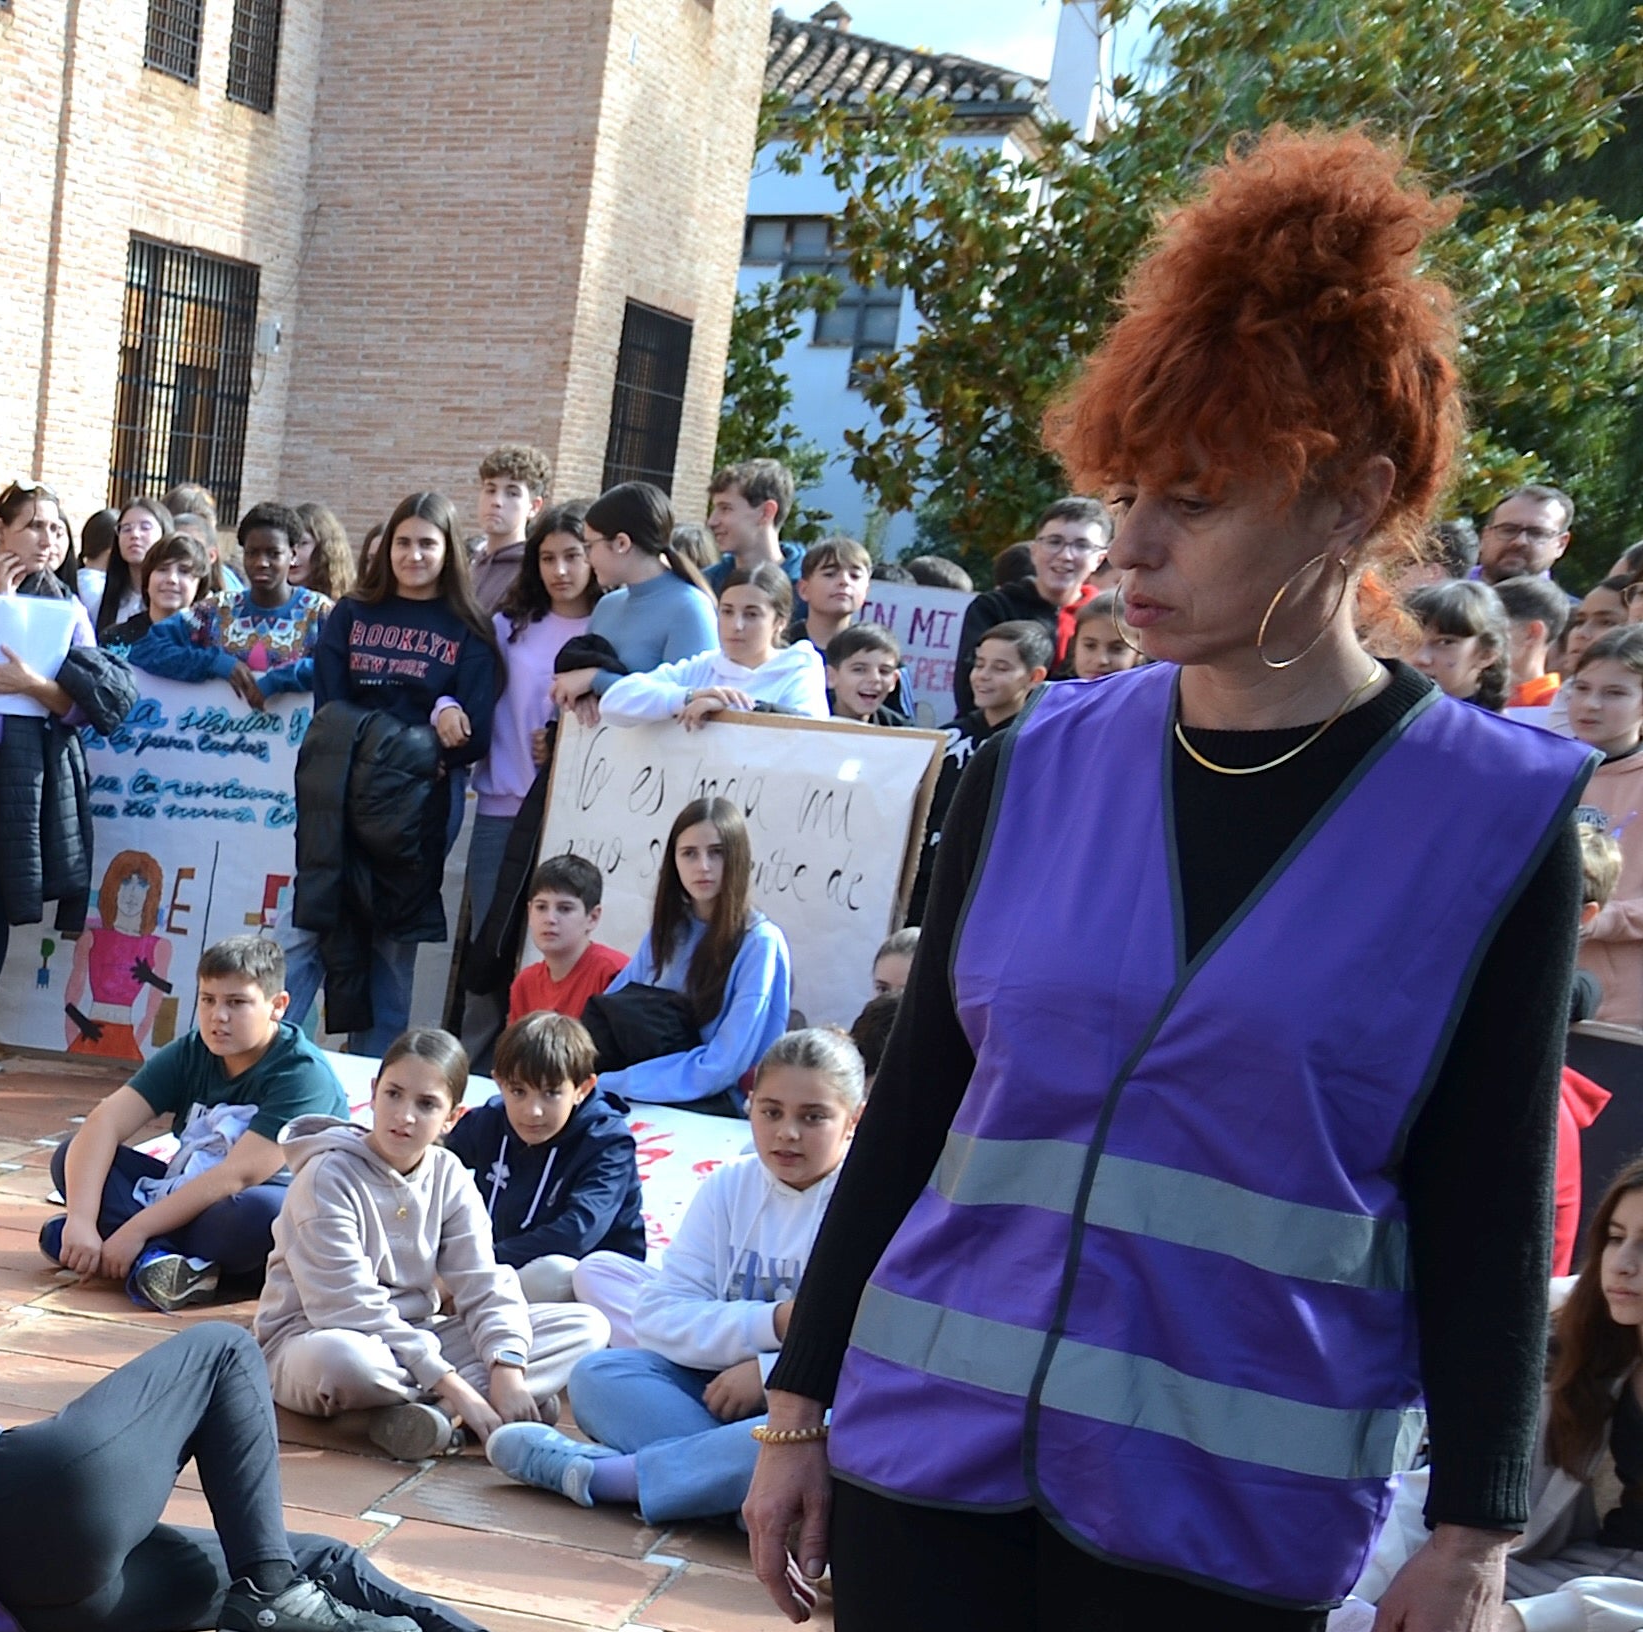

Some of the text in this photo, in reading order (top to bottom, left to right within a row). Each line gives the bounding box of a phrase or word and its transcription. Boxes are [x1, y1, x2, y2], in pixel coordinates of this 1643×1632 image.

[907, 606, 959, 650] MI
[349, 651, 430, 679] NEW YORK
[826, 846, 864, 912] de
